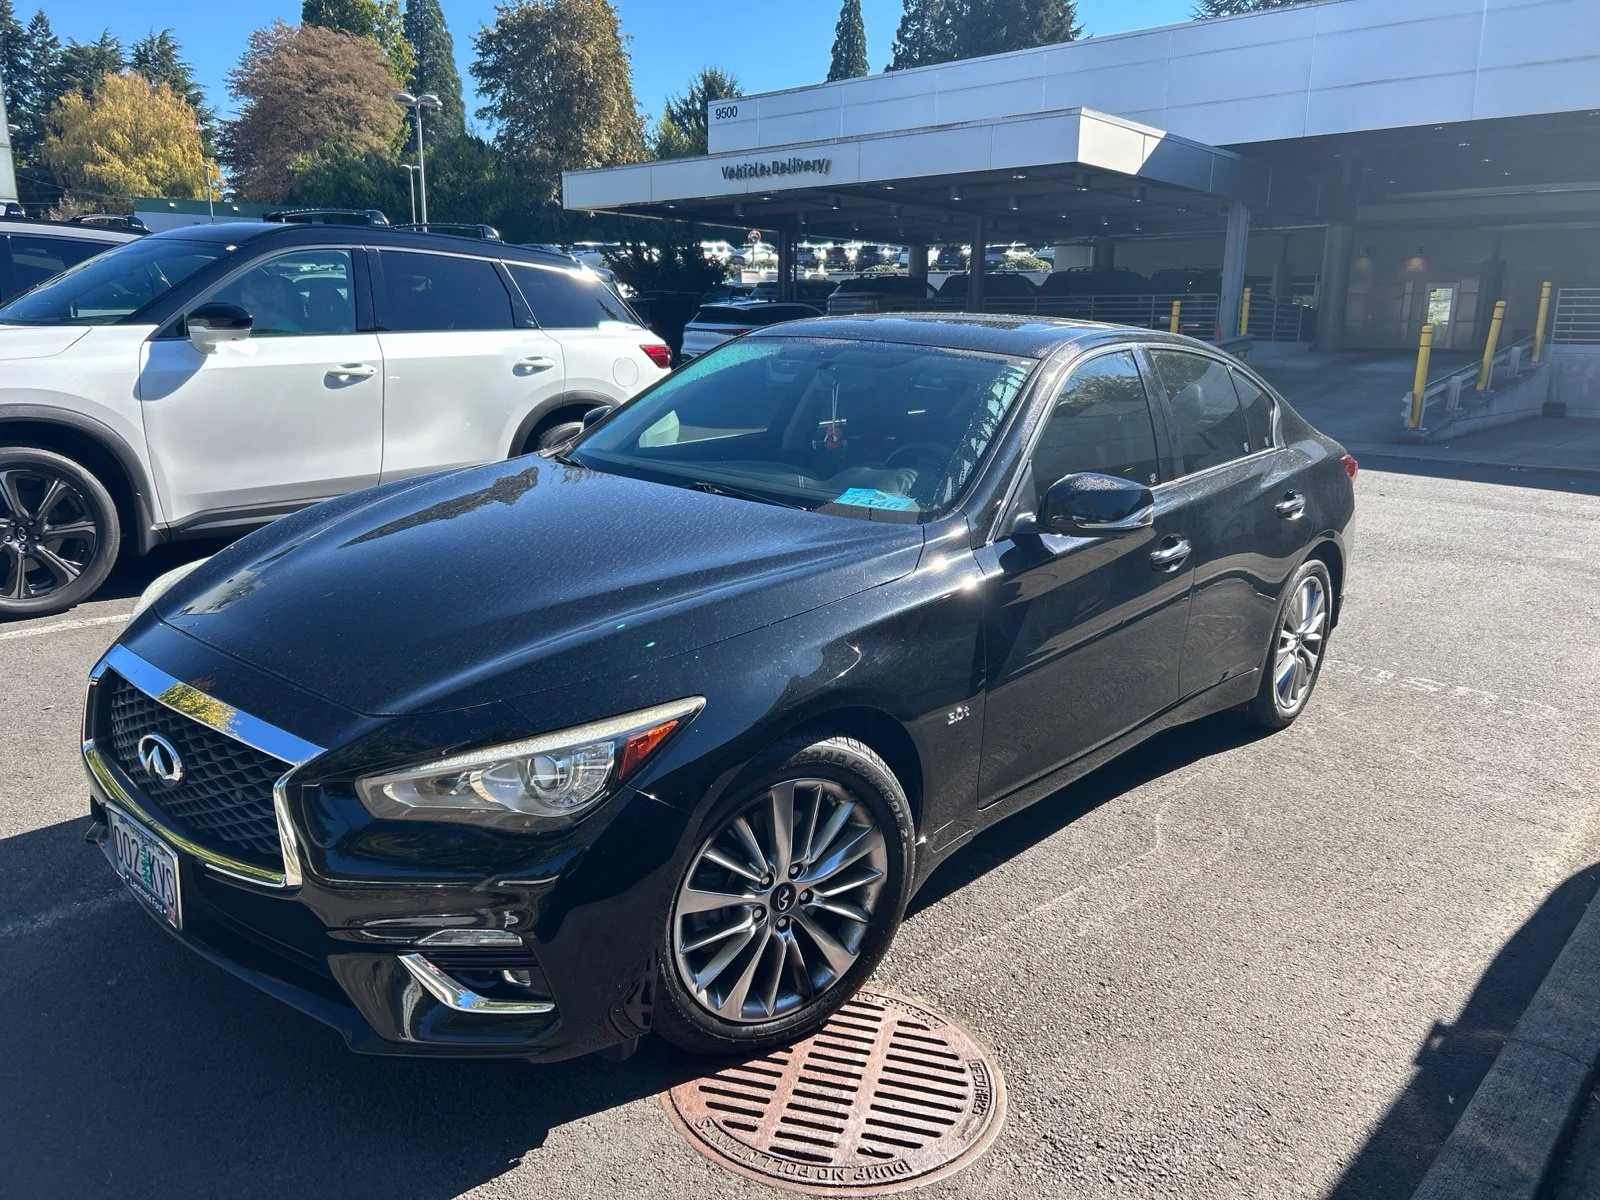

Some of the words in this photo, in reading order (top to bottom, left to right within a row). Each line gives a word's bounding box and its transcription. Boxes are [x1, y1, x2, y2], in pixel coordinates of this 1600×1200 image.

[715, 105, 738, 120] 9500
[721, 162, 767, 179] Vehicle
[771, 157, 829, 176] Delivery
[113, 825, 142, 879] 002
[816, 1167, 847, 1181] NO
[853, 1160, 909, 1181] DUMP
